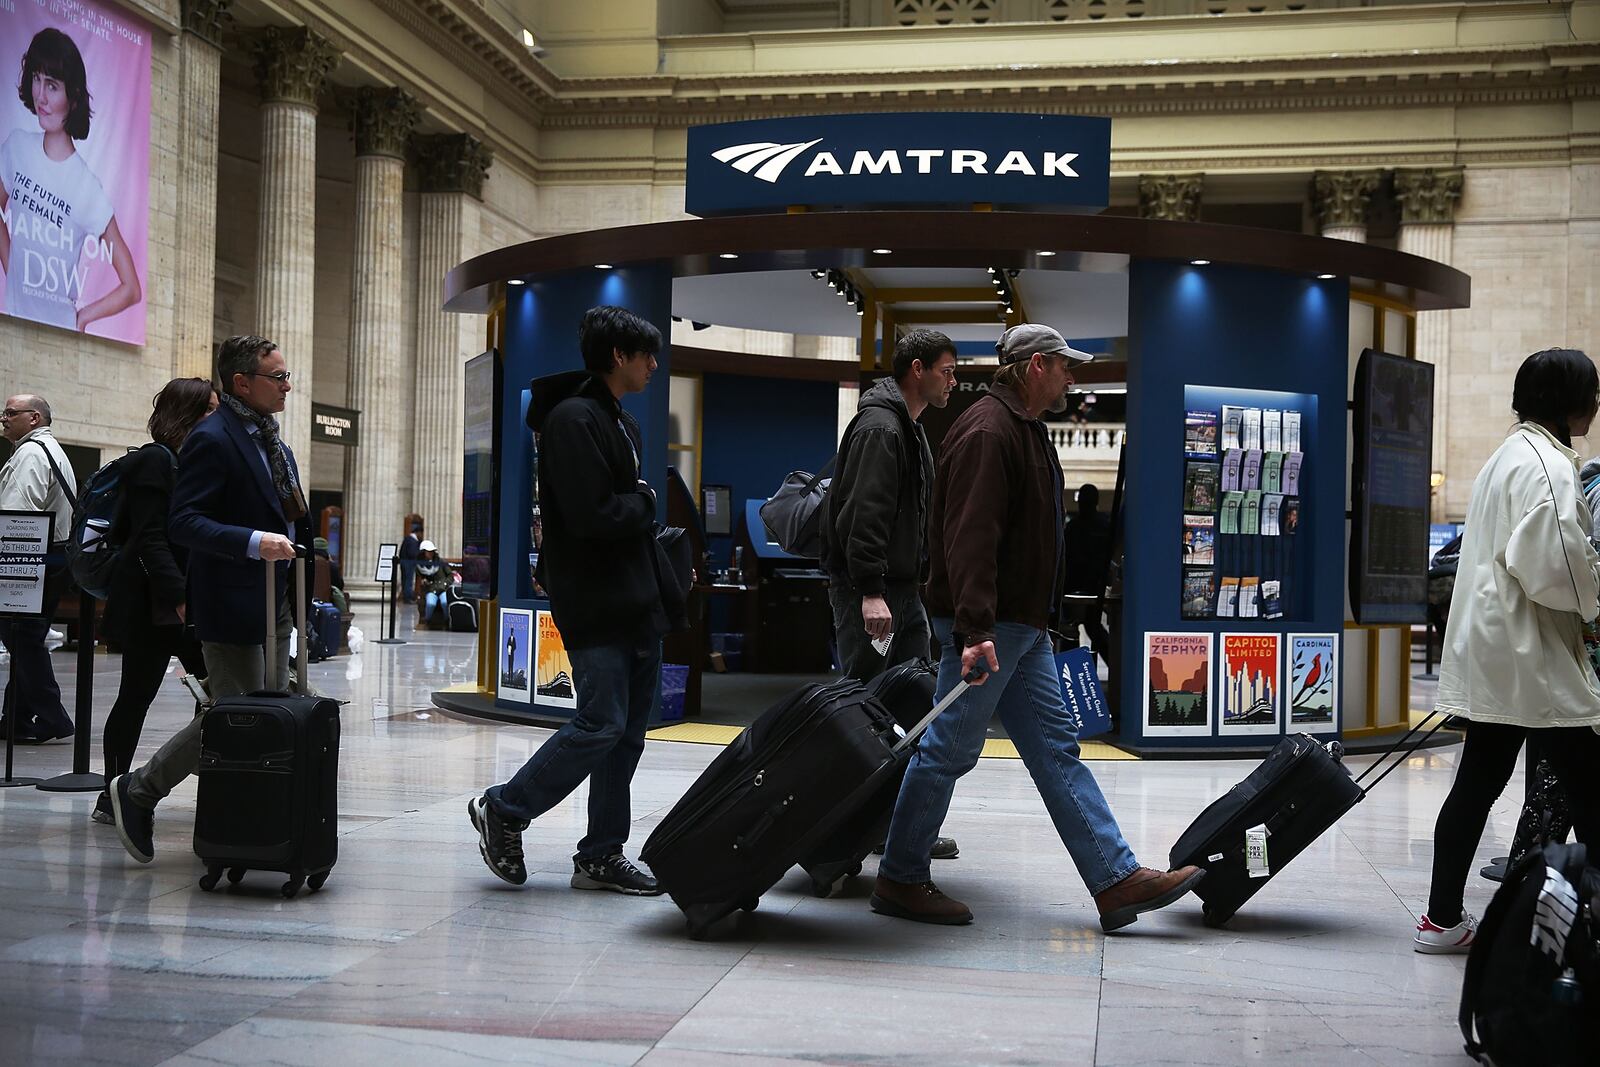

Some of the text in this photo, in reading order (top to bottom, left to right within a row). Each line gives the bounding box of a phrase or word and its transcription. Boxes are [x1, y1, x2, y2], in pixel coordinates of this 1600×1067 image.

[63, 8, 79, 25] THE
[88, 9, 100, 21] IN
[99, 15, 114, 31] THE
[116, 24, 144, 46] HOUSE.
[804, 149, 1080, 178] AMTRAK
[11, 187, 64, 229] IS FEMALE
[14, 171, 72, 217] THE FUTURE
[84, 234, 114, 265] ON
[23, 249, 90, 298] DSW
[316, 414, 351, 429] BURLINGTON
[325, 426, 342, 437] ROOM
[2, 543, 10, 551] 26
[12, 544, 30, 552] THRU
[0, 566, 7, 574] 51
[9, 567, 28, 575] THRU
[1152, 645, 1208, 656] ZEPHYR
[1226, 638, 1276, 648] CAPITOL
[1296, 640, 1332, 648] CARDINAL
[1083, 662, 1091, 681] Service
[1094, 700, 1104, 717] Closed
[1065, 682, 1083, 728] AMTRAK
[1529, 866, 1579, 967] NIKE
